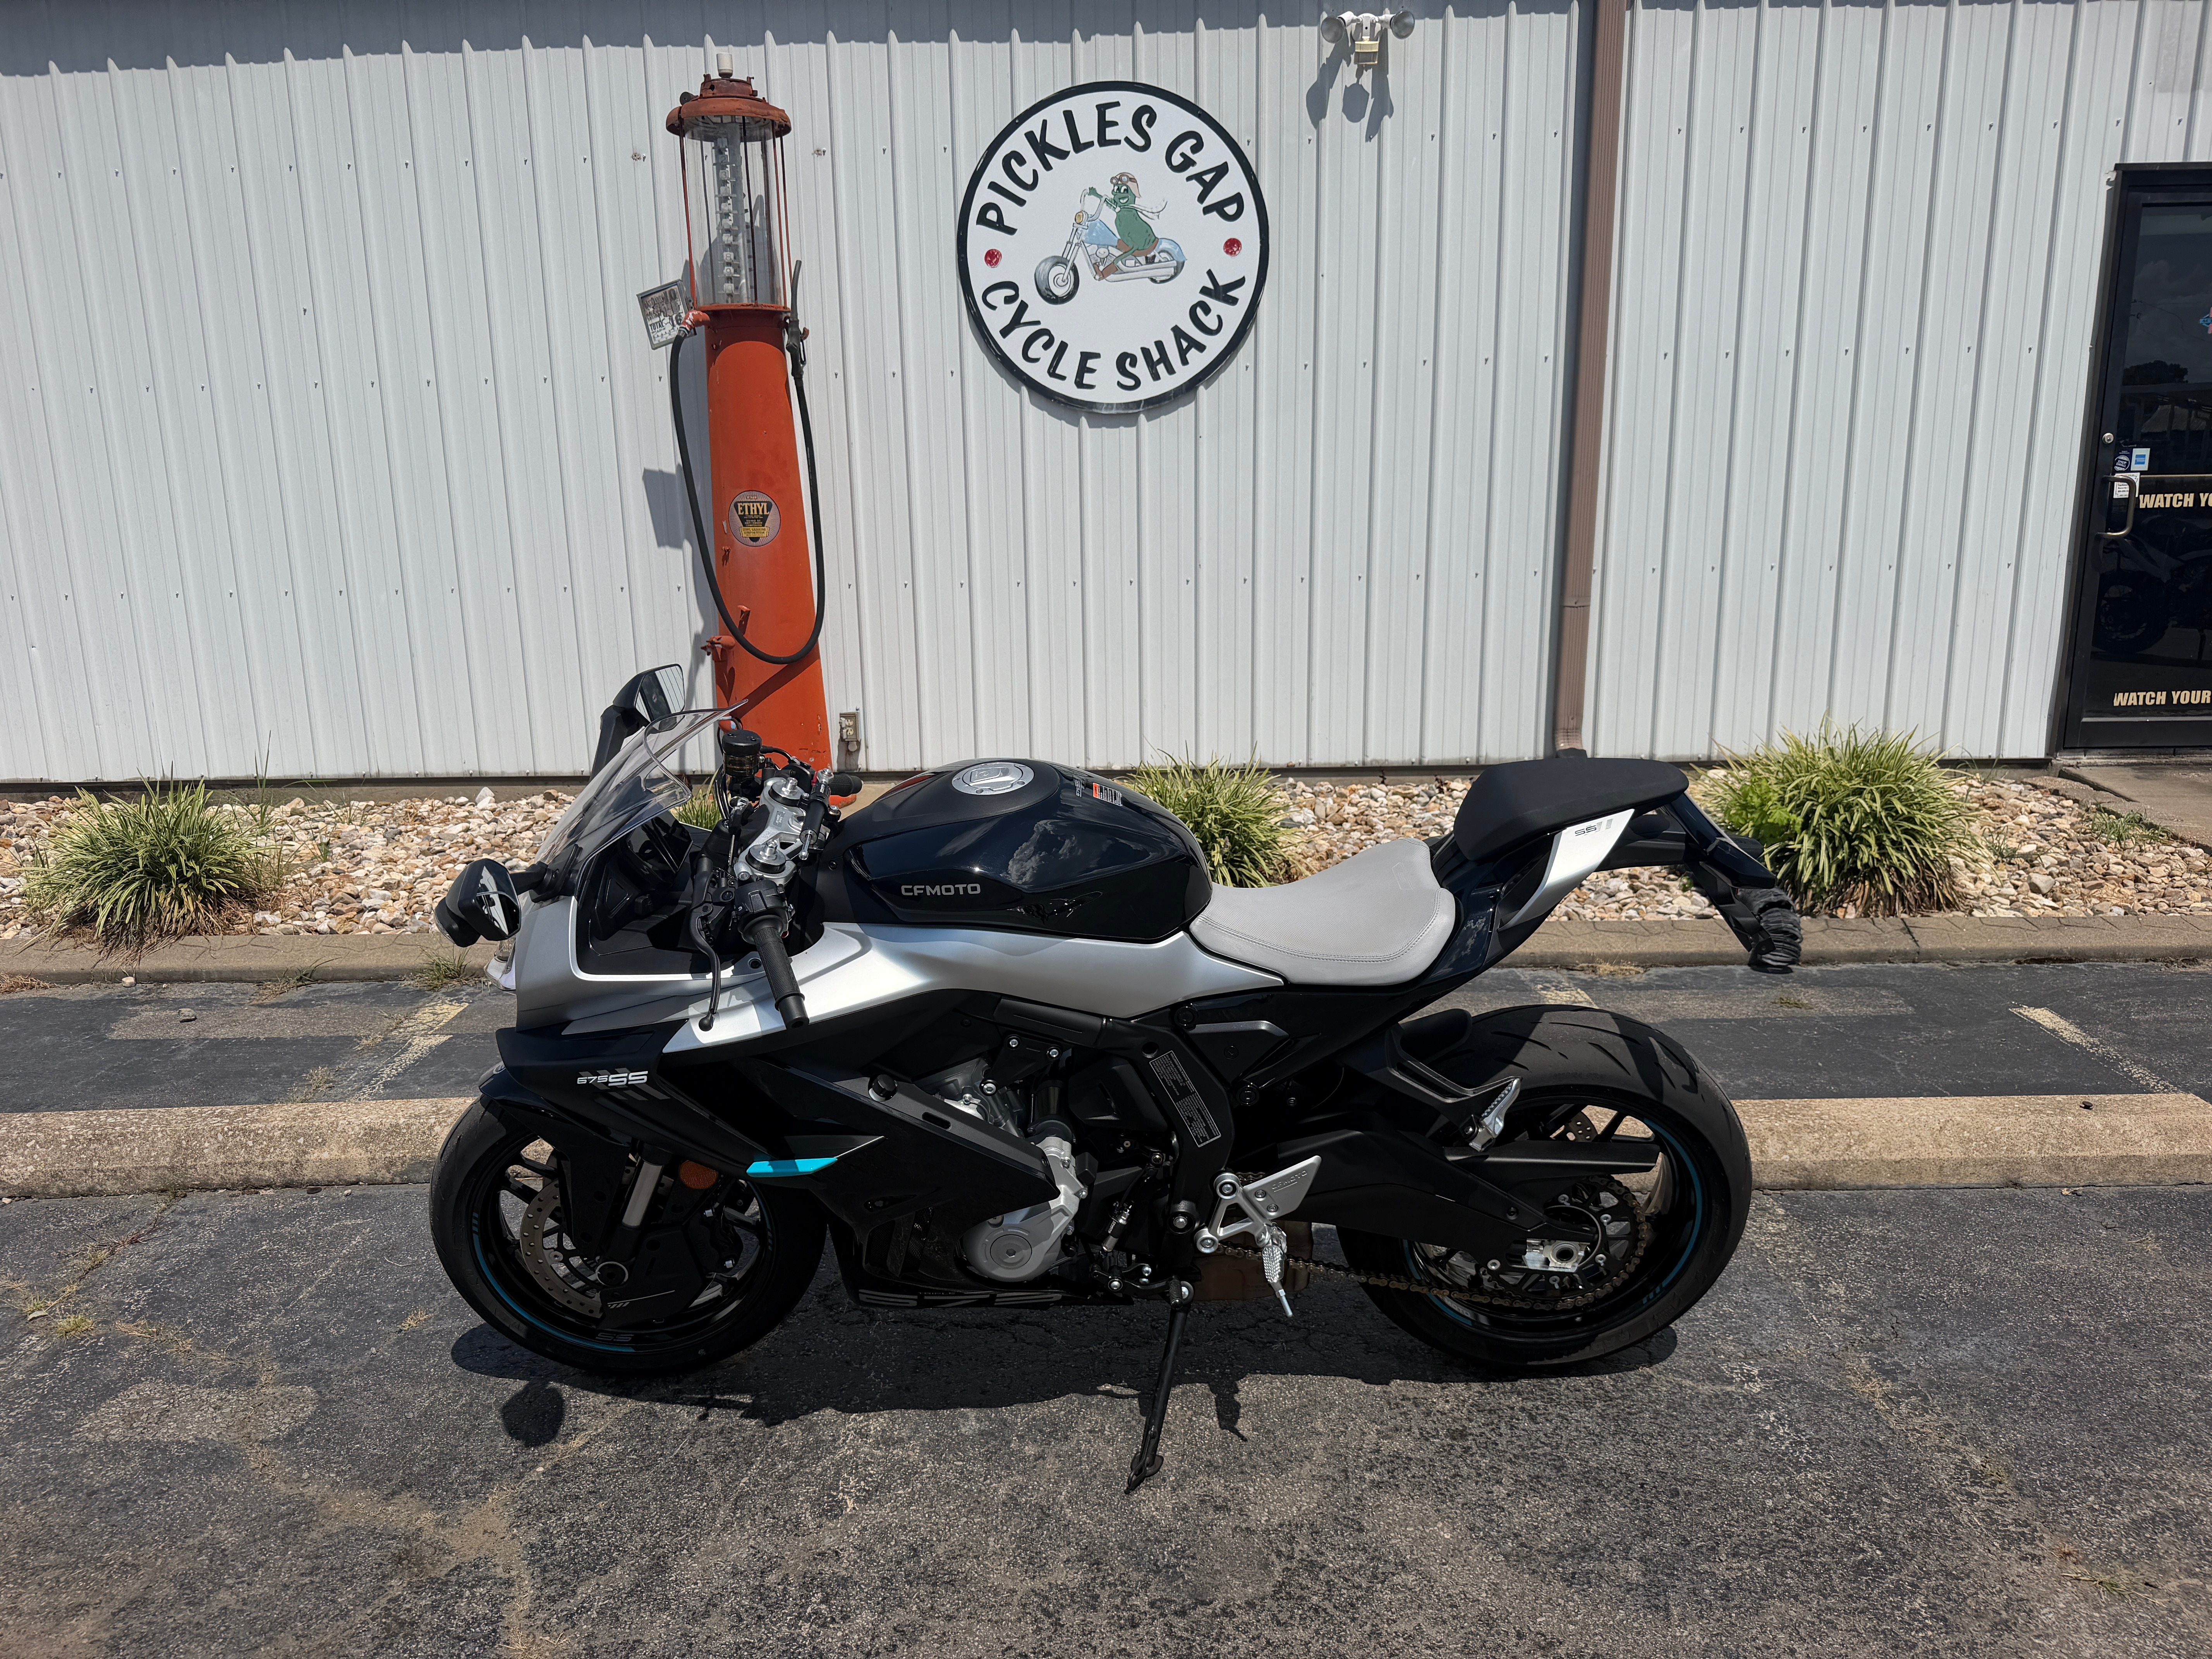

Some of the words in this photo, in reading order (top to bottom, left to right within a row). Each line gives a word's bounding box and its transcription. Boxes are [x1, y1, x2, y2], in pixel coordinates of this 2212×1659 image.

[976, 101, 1157, 235] PICKLES
[1165, 131, 1244, 222] GAP
[649, 321, 665, 331] TOTAL
[982, 281, 1101, 389] CYCLE
[1116, 269, 1245, 391] SHACK
[2139, 493, 2195, 508] WATCH
[737, 502, 770, 515] ETHYL
[2113, 691, 2167, 706] WATCH
[2172, 690, 2212, 704] YOUR
[1575, 825, 1597, 836] SS
[901, 883, 981, 896] CFMOTO
[595, 1332, 635, 1342] SS
